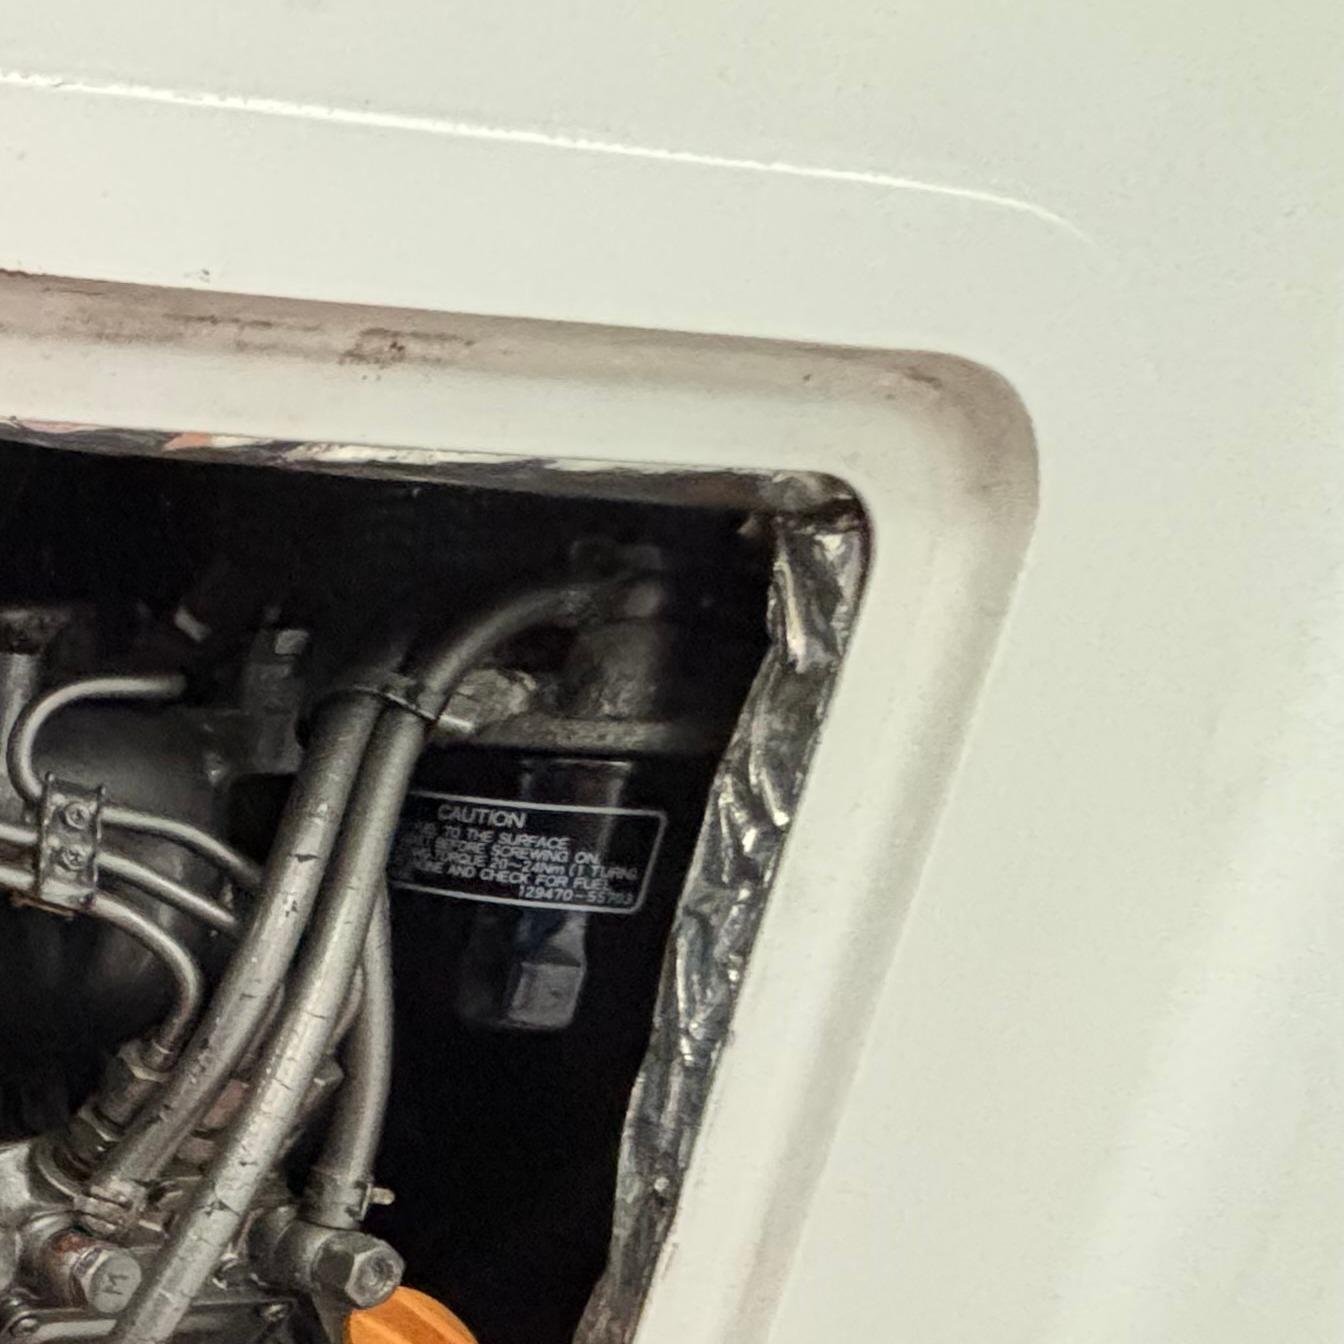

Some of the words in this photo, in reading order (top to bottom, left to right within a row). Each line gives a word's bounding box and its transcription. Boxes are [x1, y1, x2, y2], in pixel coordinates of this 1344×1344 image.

[437, 803, 526, 829] CAUTION
[466, 828, 493, 843] THE
[498, 831, 570, 849] SURFACE
[447, 860, 476, 878] AND
[479, 867, 528, 884] CHECK
[534, 873, 569, 887] FOR
